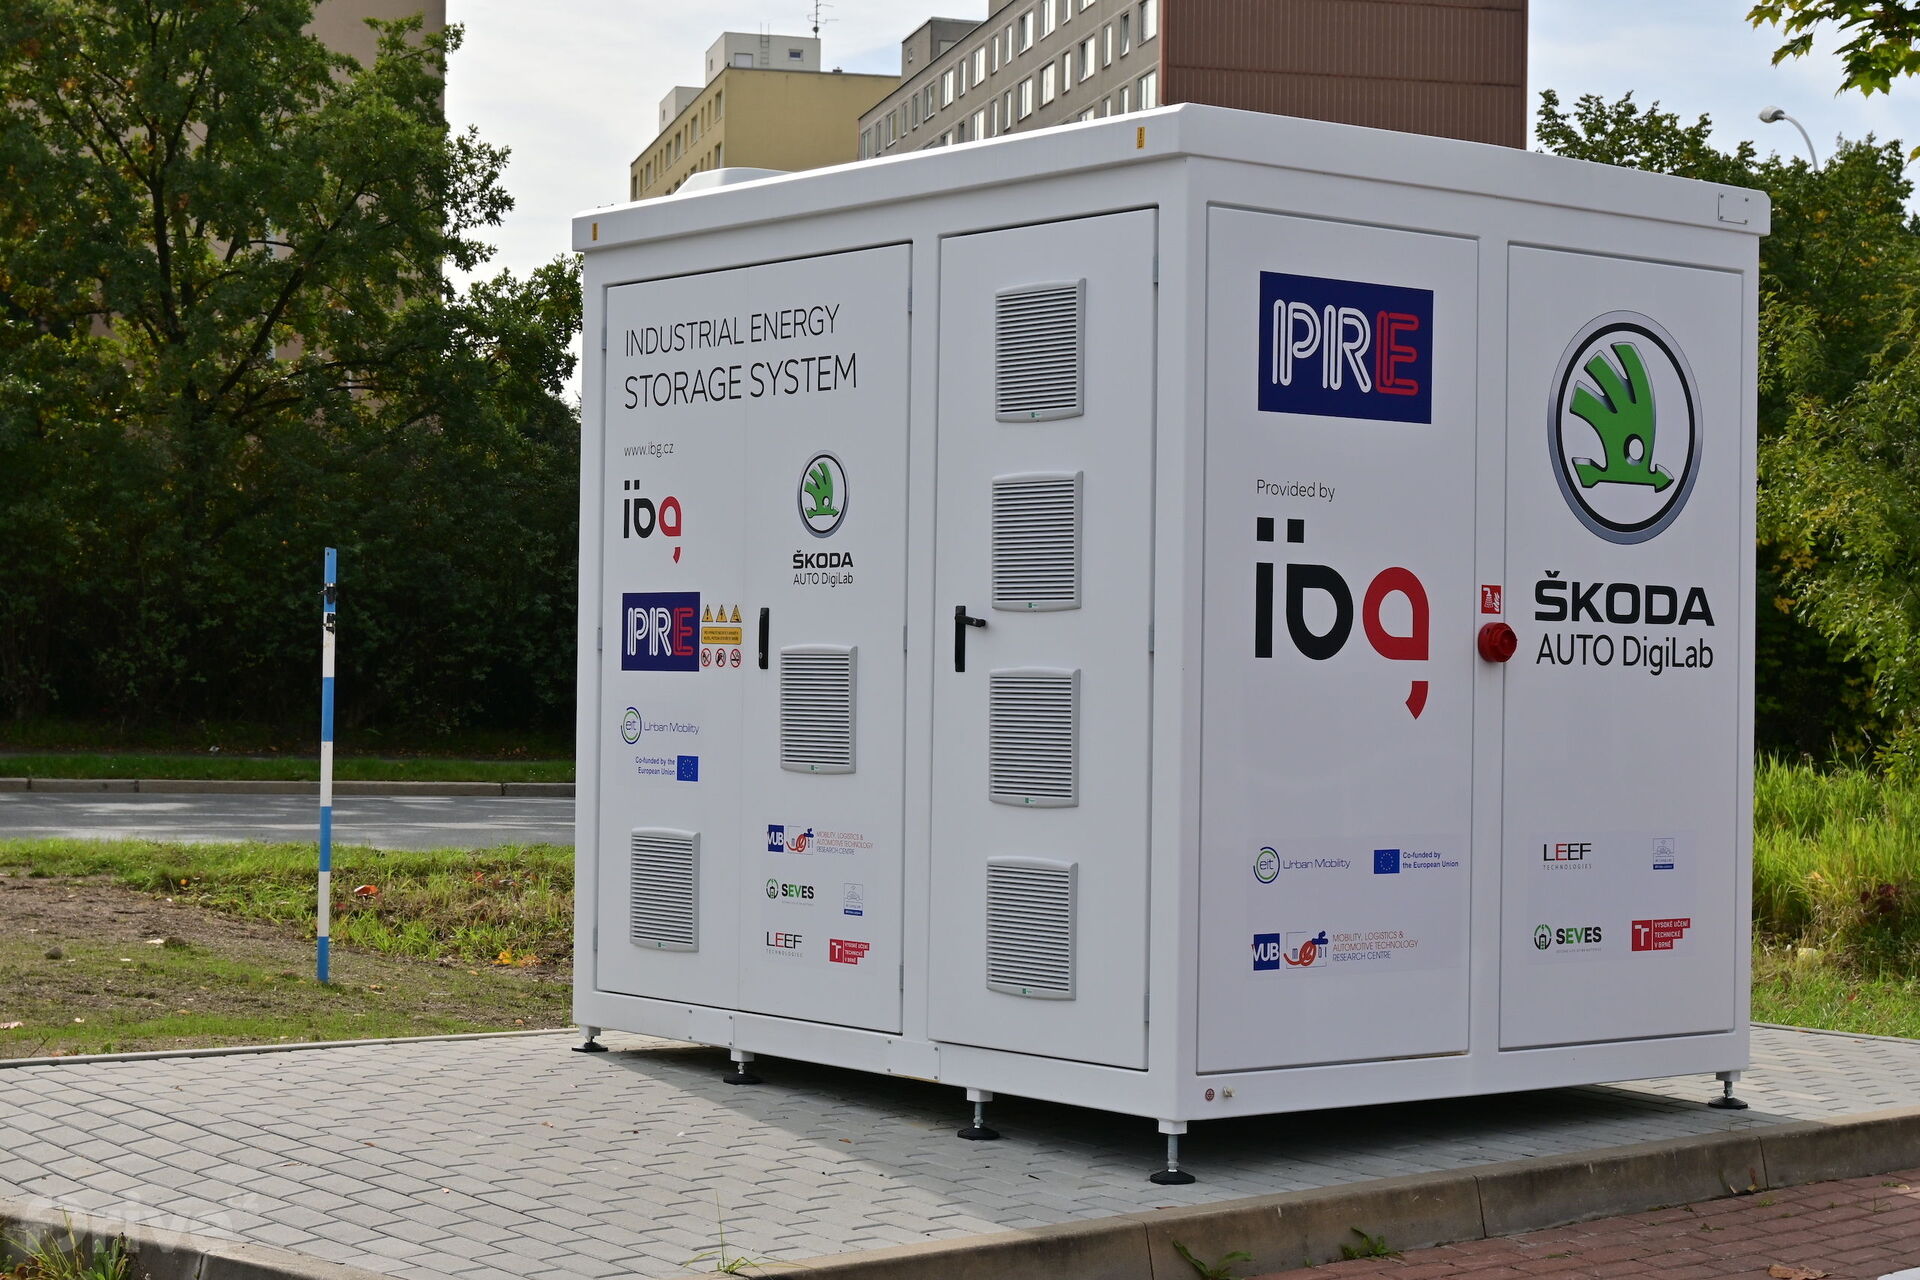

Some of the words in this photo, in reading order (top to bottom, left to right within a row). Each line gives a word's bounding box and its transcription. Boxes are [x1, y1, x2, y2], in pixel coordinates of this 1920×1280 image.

[625, 316, 744, 357] INDUSTRIAL
[750, 303, 840, 343] ENERGY
[1272, 299, 1419, 396] PRE
[624, 365, 742, 410] STORAGE
[750, 352, 857, 399] SYSTEM
[624, 441, 674, 458] www.ibg.cz
[1256, 479, 1316, 498] Provided
[1319, 483, 1336, 502] by
[792, 549, 854, 569] ŠKODA
[793, 572, 820, 585] AUTO
[821, 571, 854, 588] DigiLab
[1534, 569, 1716, 627] ŠKODA
[627, 607, 694, 657] PRE
[1535, 632, 1614, 667] AUTO
[1623, 637, 1714, 676] DigiLab
[643, 722, 669, 732] Urban
[1402, 851, 1433, 859] Co-funded
[1433, 851, 1441, 860] by
[1543, 843, 1592, 861] LEEF
[1259, 859, 1275, 871] eit
[1282, 860, 1314, 871] Urban
[1314, 858, 1352, 870] Mobility
[1413, 861, 1441, 869] European
[1441, 860, 1459, 868] Union
[781, 883, 815, 900] SEVES
[766, 931, 803, 949] LEEF
[1364, 930, 1397, 941] LOGISTICS
[1555, 926, 1602, 945] SEVES
[1254, 942, 1280, 962] VUB
[1332, 941, 1374, 952] AUTOMOTIVE
[1375, 939, 1418, 950] TECHNOLOGY
[1332, 952, 1366, 962] RESEARCH
[1366, 951, 1392, 960] CENTRE
